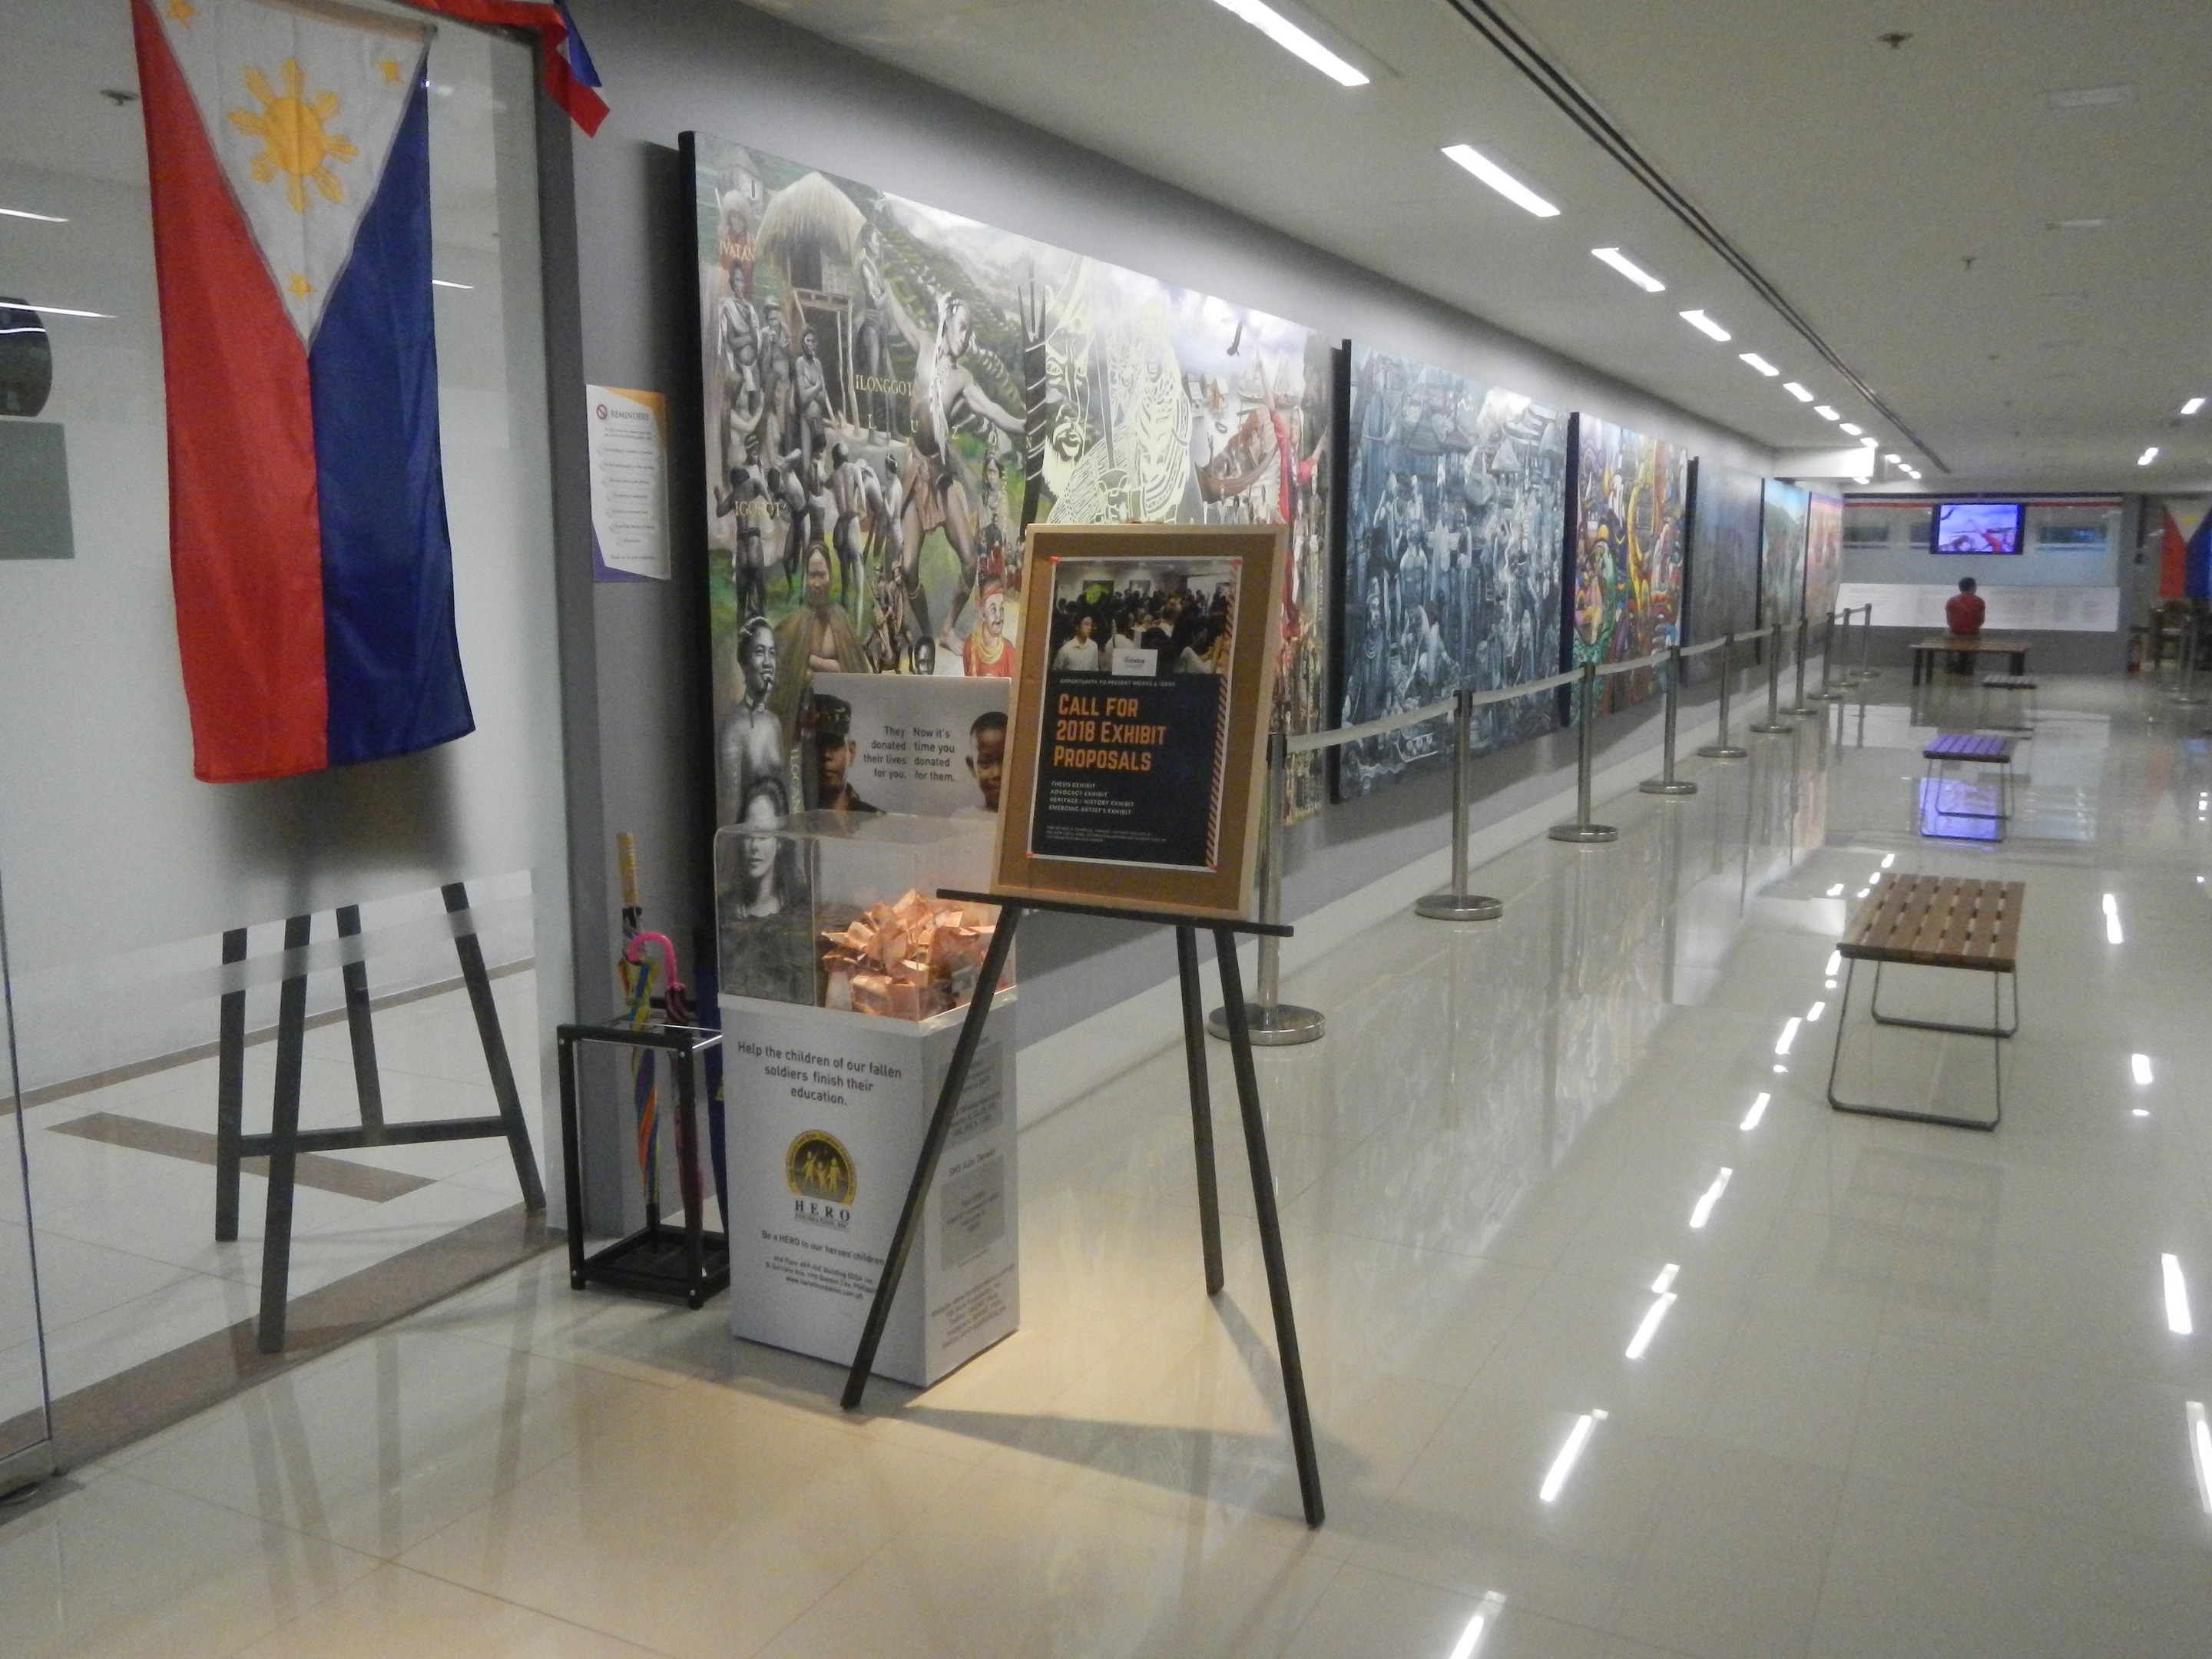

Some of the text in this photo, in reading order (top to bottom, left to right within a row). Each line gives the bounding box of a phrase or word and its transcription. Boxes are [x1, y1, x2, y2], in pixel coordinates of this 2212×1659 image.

[855, 374, 912, 396] ILONGGOT
[611, 409, 650, 421] REMINDERS
[1058, 694, 1139, 717] CALL FOR
[884, 726, 906, 739] They
[913, 727, 933, 738] Now
[1056, 720, 1167, 745] 2018 EXHIBIT
[871, 740, 906, 750] donated
[914, 741, 955, 754] time you
[863, 754, 907, 765] their lives
[914, 757, 950, 767] donated
[1054, 745, 1151, 771] PROPOSALS
[874, 769, 906, 780] for you.
[930, 772, 955, 782] them.
[738, 1041, 902, 1078] Help the children of our fallen
[764, 1065, 873, 1092] soldiers finish their
[790, 1087, 848, 1106] education.
[795, 1200, 850, 1222] HERO
[762, 1230, 772, 1240] Be
[780, 1234, 800, 1247] HERO
[811, 1243, 823, 1251] our
